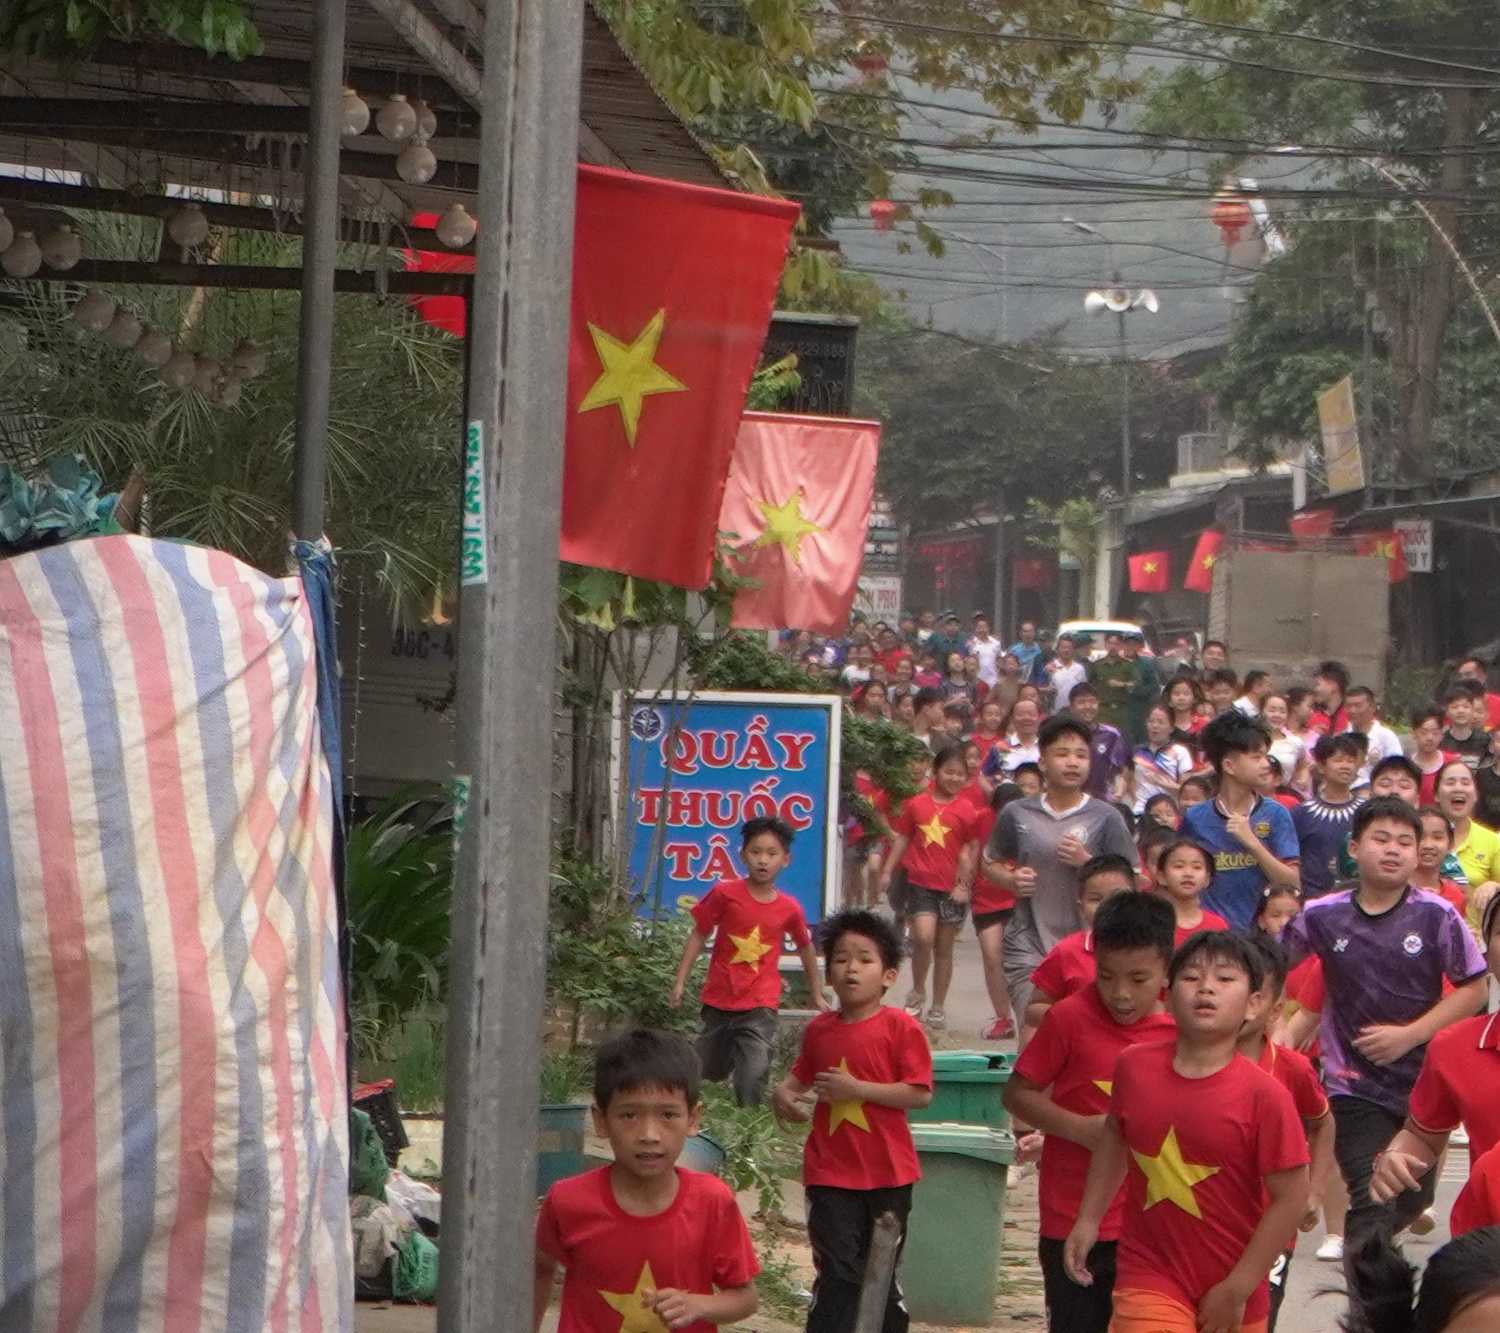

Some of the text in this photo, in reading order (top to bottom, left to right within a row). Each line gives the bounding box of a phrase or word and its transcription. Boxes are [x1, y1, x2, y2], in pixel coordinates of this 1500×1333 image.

[660, 716, 815, 774] QUẦY
[635, 777, 814, 830] THUỐC
[664, 834, 744, 883] TÂ
